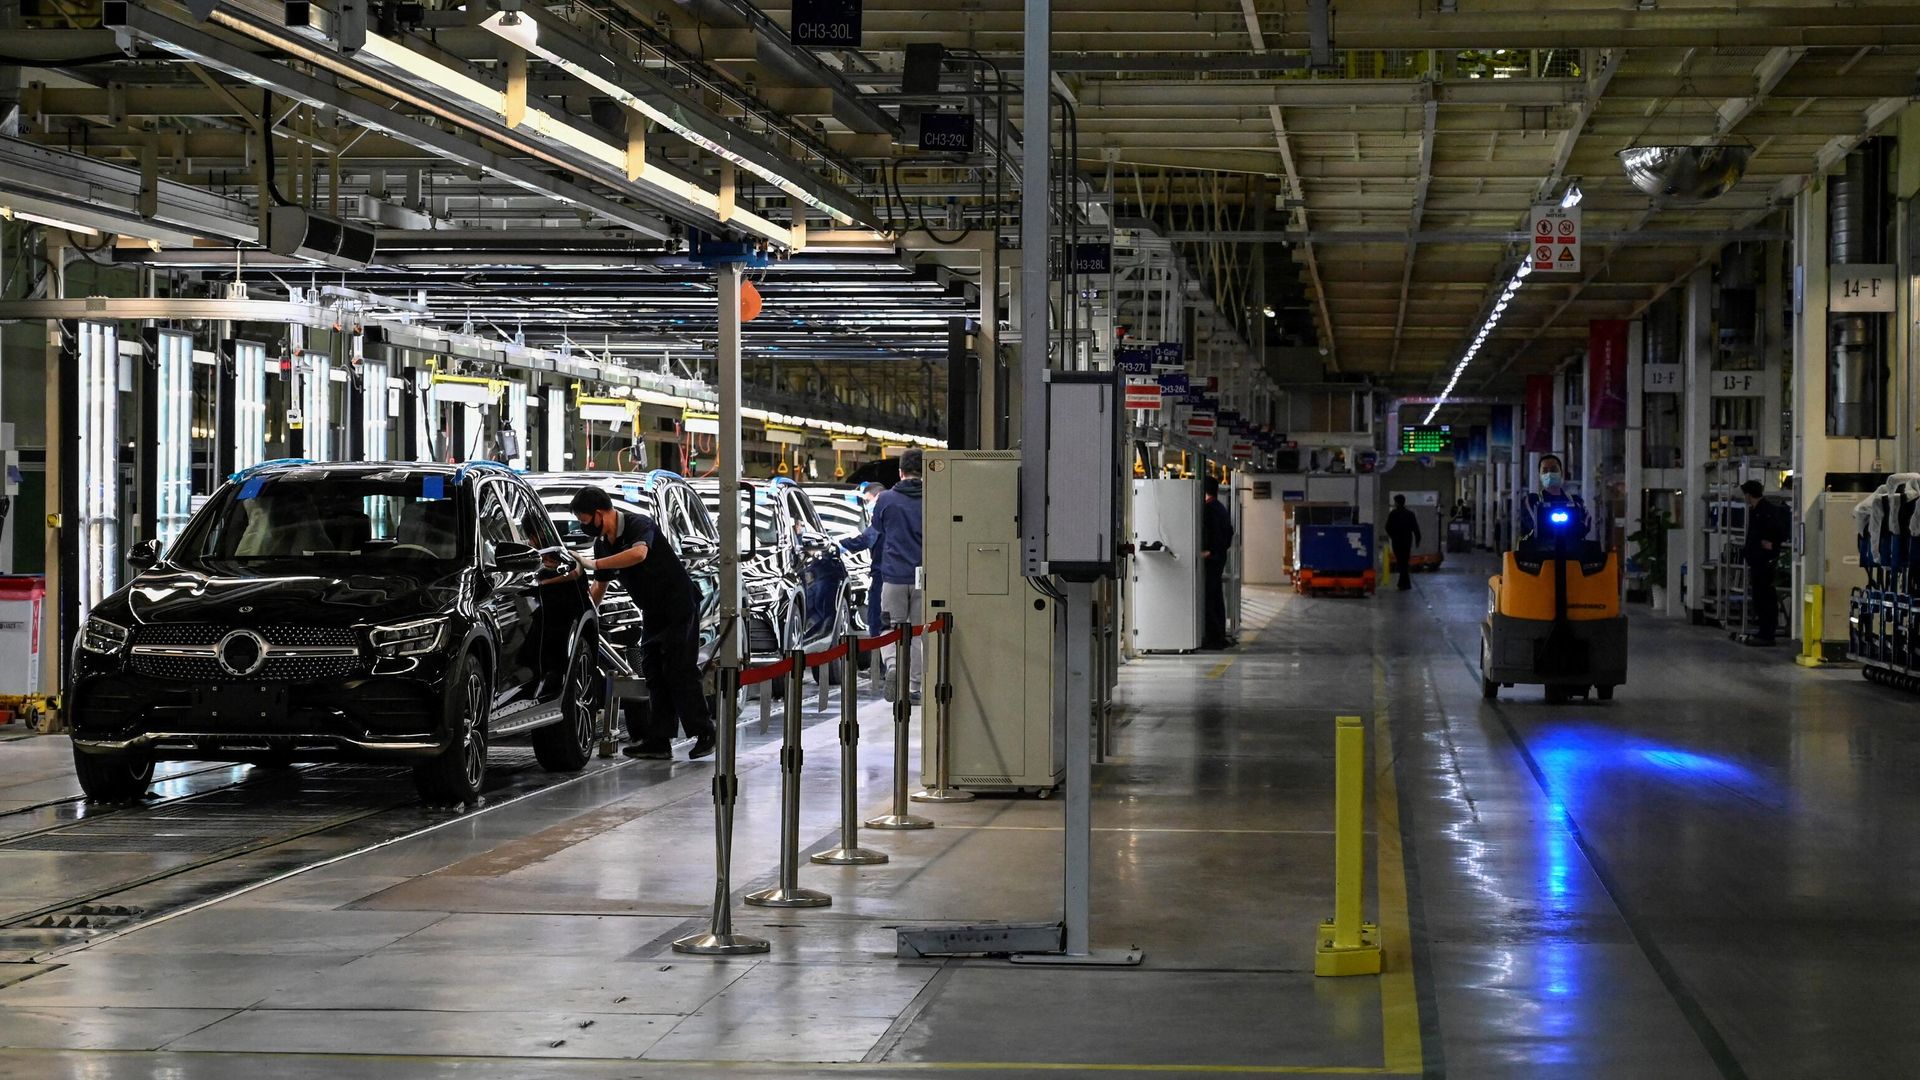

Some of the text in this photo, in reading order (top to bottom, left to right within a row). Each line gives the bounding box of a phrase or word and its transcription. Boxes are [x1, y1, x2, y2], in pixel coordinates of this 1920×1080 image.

[799, 23, 853, 39] CH3-30L
[925, 132, 968, 147] CH3-29L
[1071, 259, 1105, 270] H3-28L
[1843, 278, 1881, 297] 14-F
[1653, 371, 1675, 384] 12-F
[1723, 376, 1752, 390] 13-F
